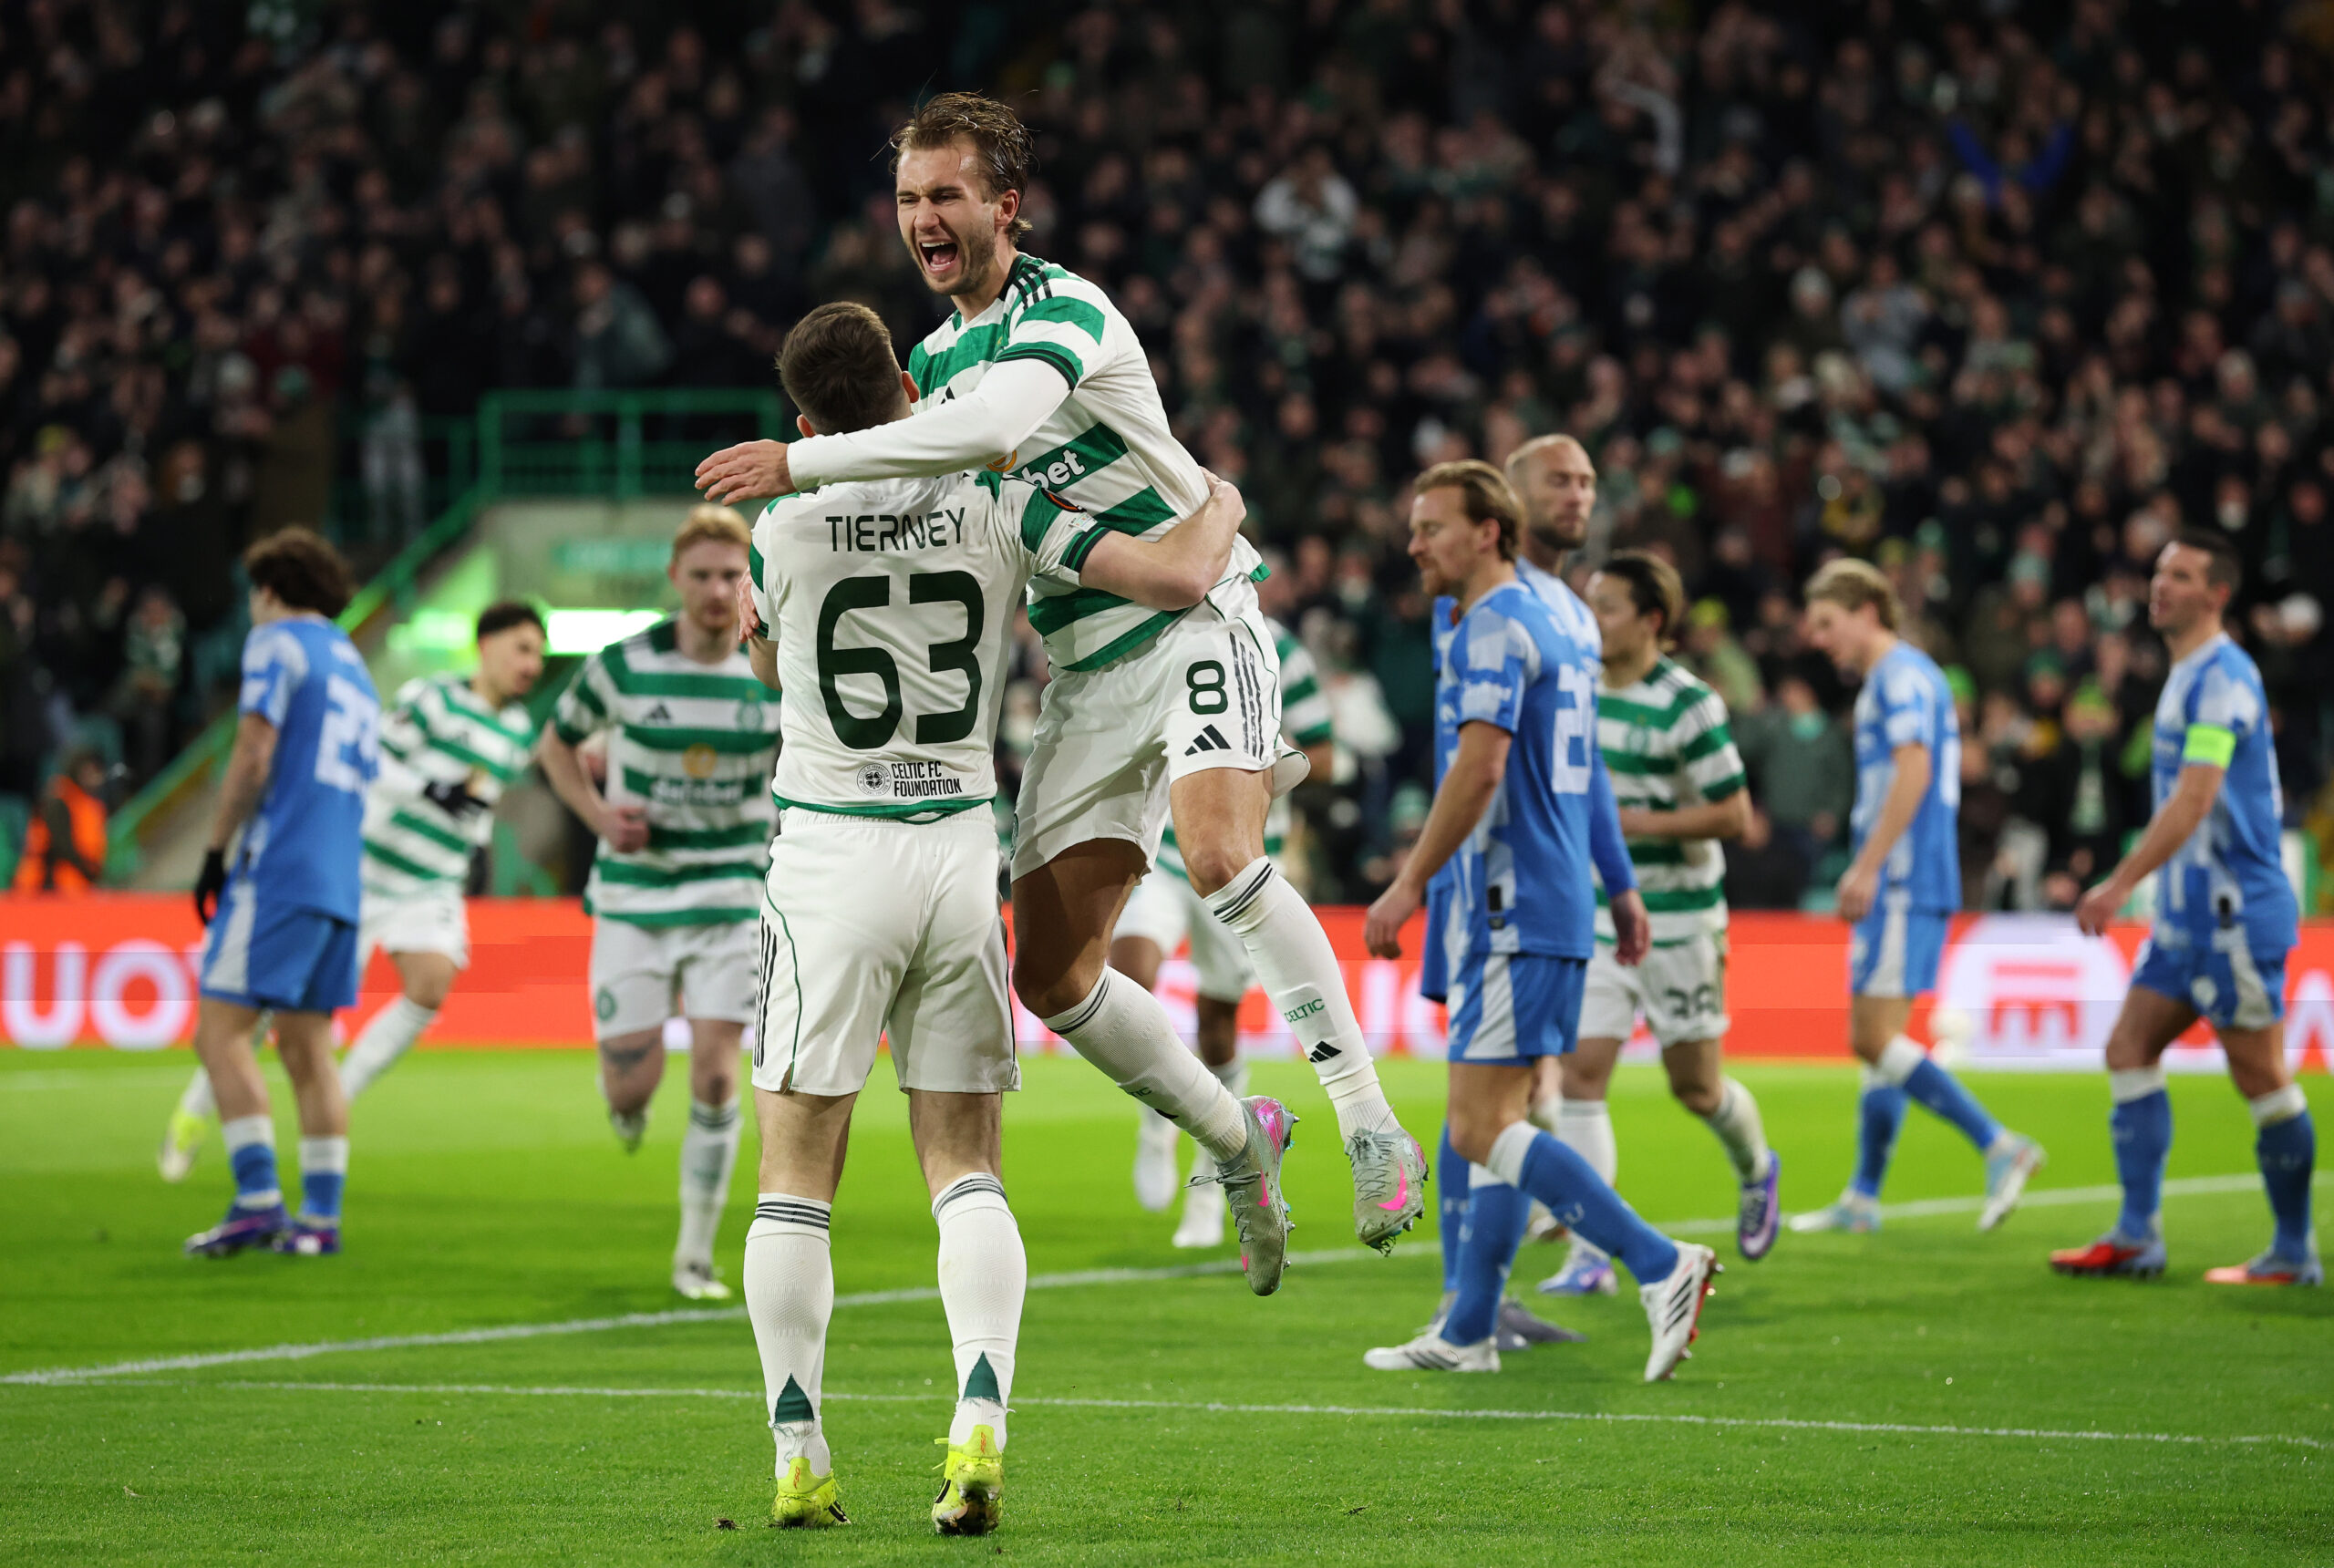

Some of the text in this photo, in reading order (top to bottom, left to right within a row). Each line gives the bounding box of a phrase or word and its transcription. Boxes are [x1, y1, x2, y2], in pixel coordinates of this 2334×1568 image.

[826, 507, 966, 552] TIERNEY
[817, 570, 985, 750] 63
[1186, 660, 1228, 716] 8
[892, 762, 924, 779] CELTIC
[927, 760, 942, 778] FC
[894, 779, 963, 797] FOUNDATION
[1284, 998, 1325, 1023] CELTIC
